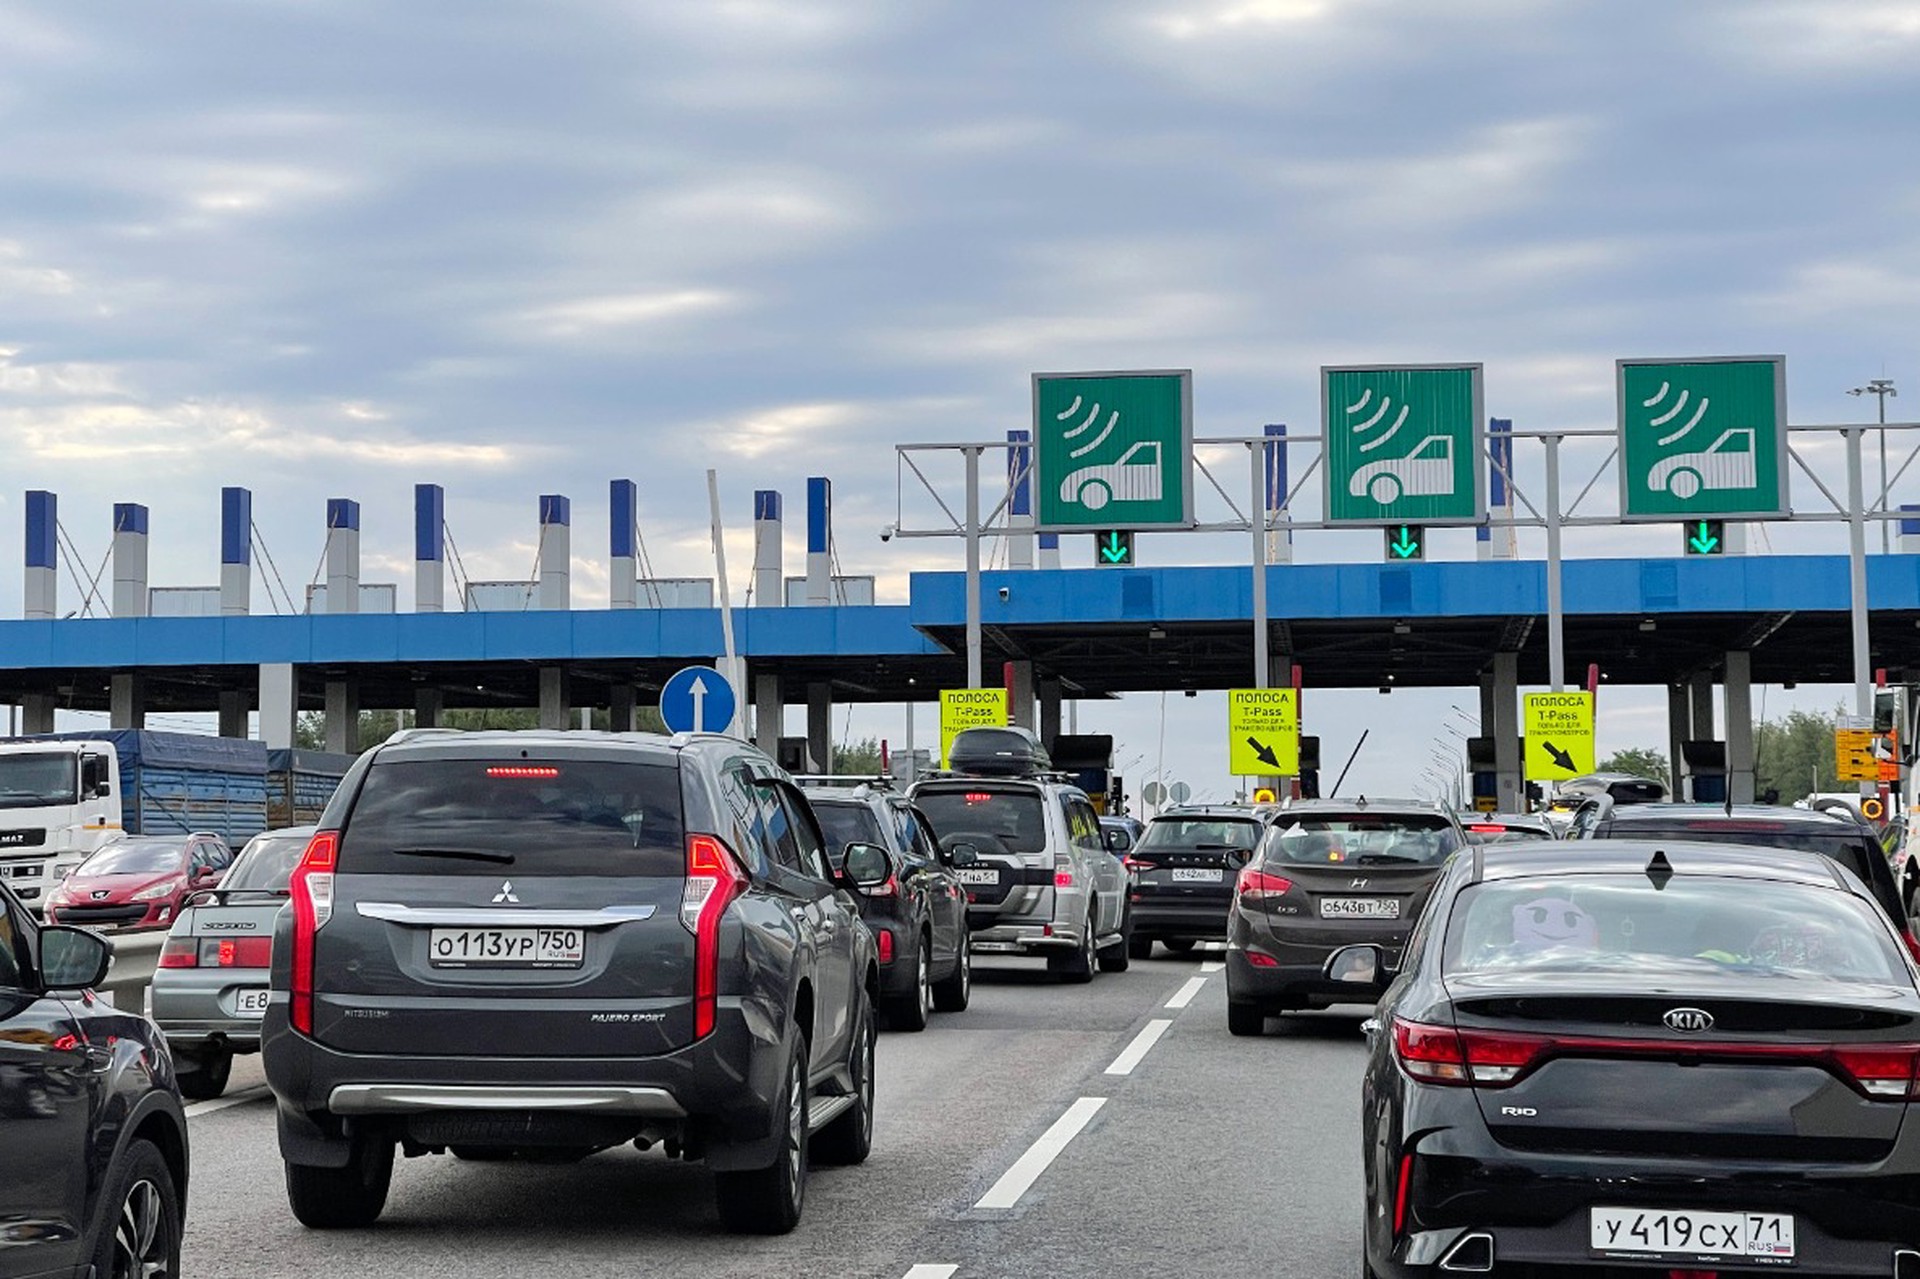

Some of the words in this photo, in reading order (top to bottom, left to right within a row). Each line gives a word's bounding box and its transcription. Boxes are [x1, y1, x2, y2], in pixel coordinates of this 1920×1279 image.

[948, 692, 1000, 703] ПОЛОСА
[1236, 692, 1289, 703] ПОЛОСА
[1531, 696, 1586, 707] ПОЛОСА
[954, 706, 993, 716] T-Pass
[1243, 706, 1282, 716] T-Pass
[1538, 710, 1578, 720] T-Pass
[437, 931, 534, 957] О113УР
[540, 931, 577, 950] 750
[591, 1013, 630, 1023] PAJERO
[631, 1013, 666, 1022] SPORT
[1671, 1012, 1707, 1029] KIA
[1501, 1106, 1538, 1117] RIO
[1606, 1214, 1739, 1249] У419СХ
[1749, 1217, 1781, 1241] 71
[1748, 1241, 1772, 1252] RUS
